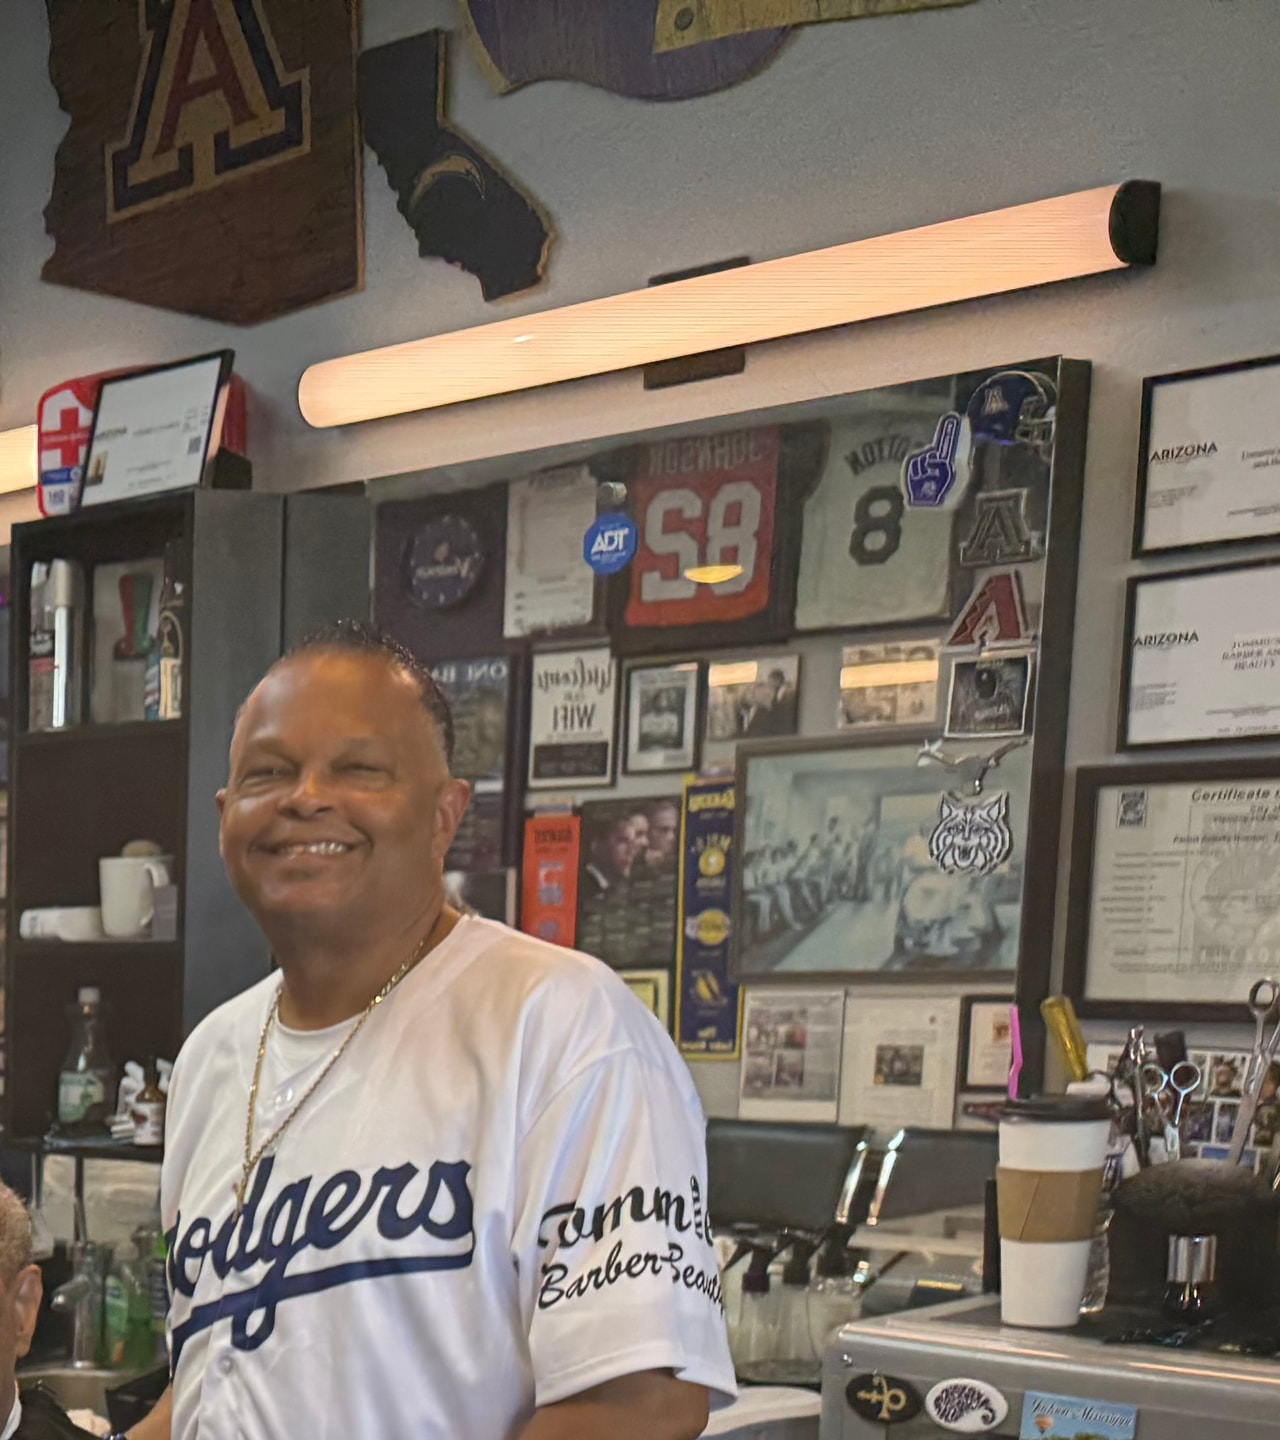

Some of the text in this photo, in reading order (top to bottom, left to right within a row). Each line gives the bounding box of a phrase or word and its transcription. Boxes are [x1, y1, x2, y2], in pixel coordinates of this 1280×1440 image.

[1150, 441, 1218, 463] ARIZONA
[848, 485, 905, 566] 8
[591, 528, 629, 554] ADT
[1134, 630, 1199, 649] ARIZONA
[1192, 786, 1271, 802] Certificate
[164, 1156, 474, 1351] odgers
